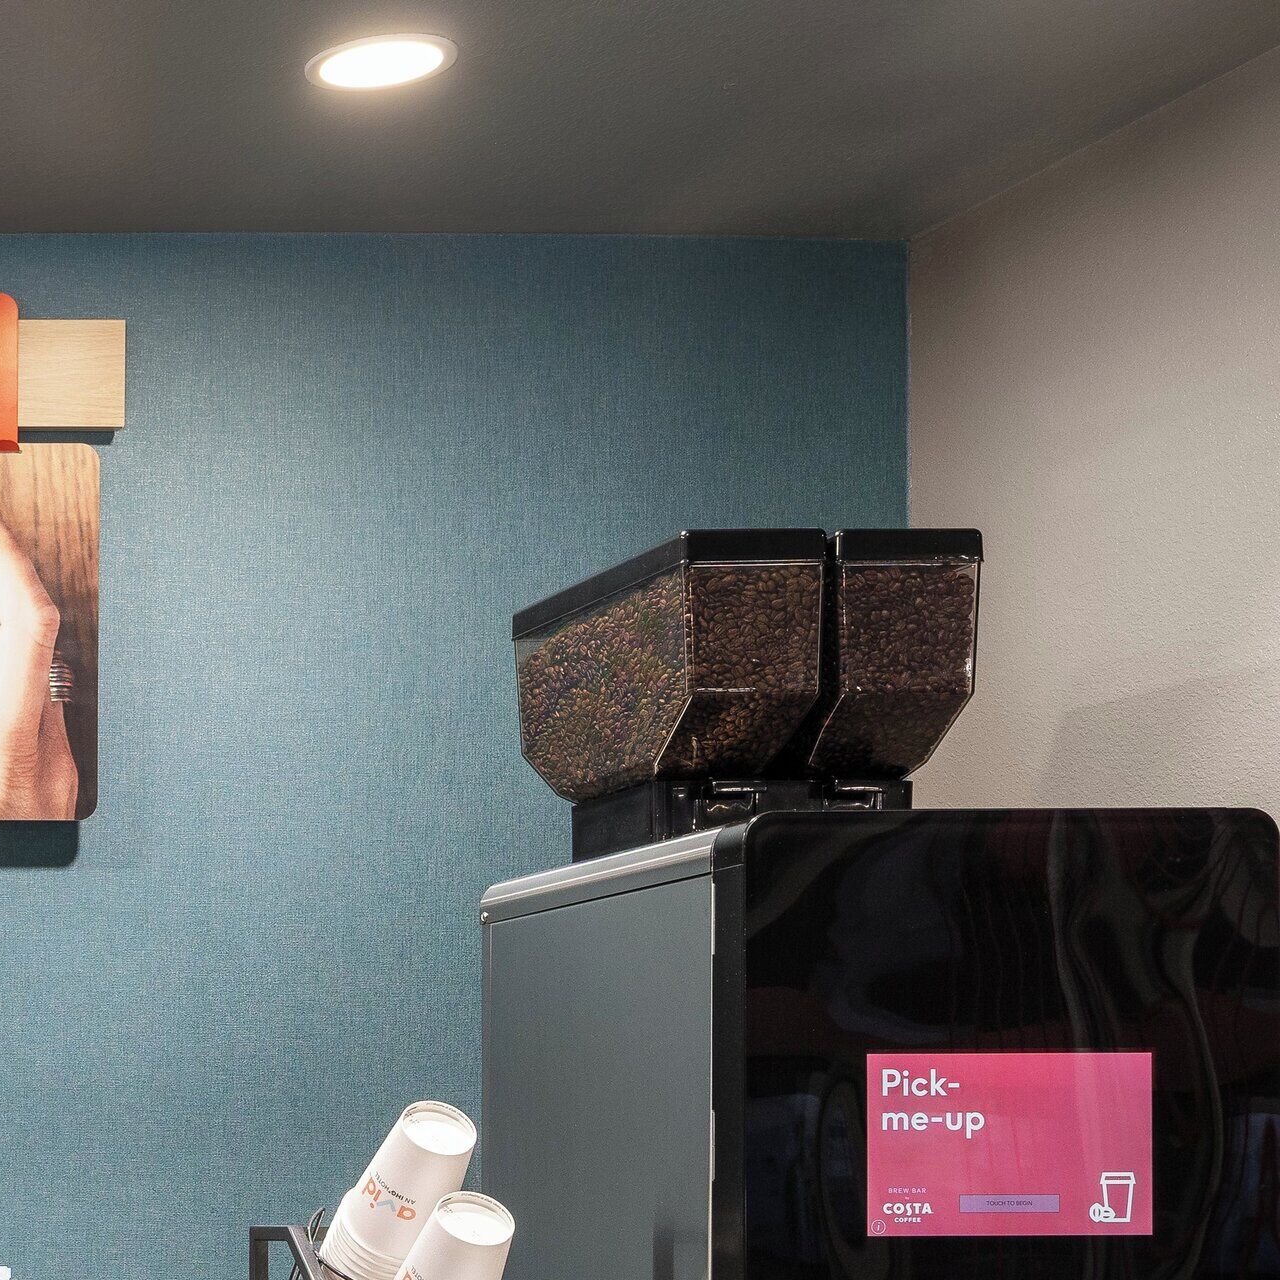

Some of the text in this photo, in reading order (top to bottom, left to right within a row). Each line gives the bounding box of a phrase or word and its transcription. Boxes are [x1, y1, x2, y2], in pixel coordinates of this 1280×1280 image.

[882, 1068, 960, 1096] Pick-
[882, 1111, 985, 1139] me-up
[882, 1203, 932, 1216] COSTA
